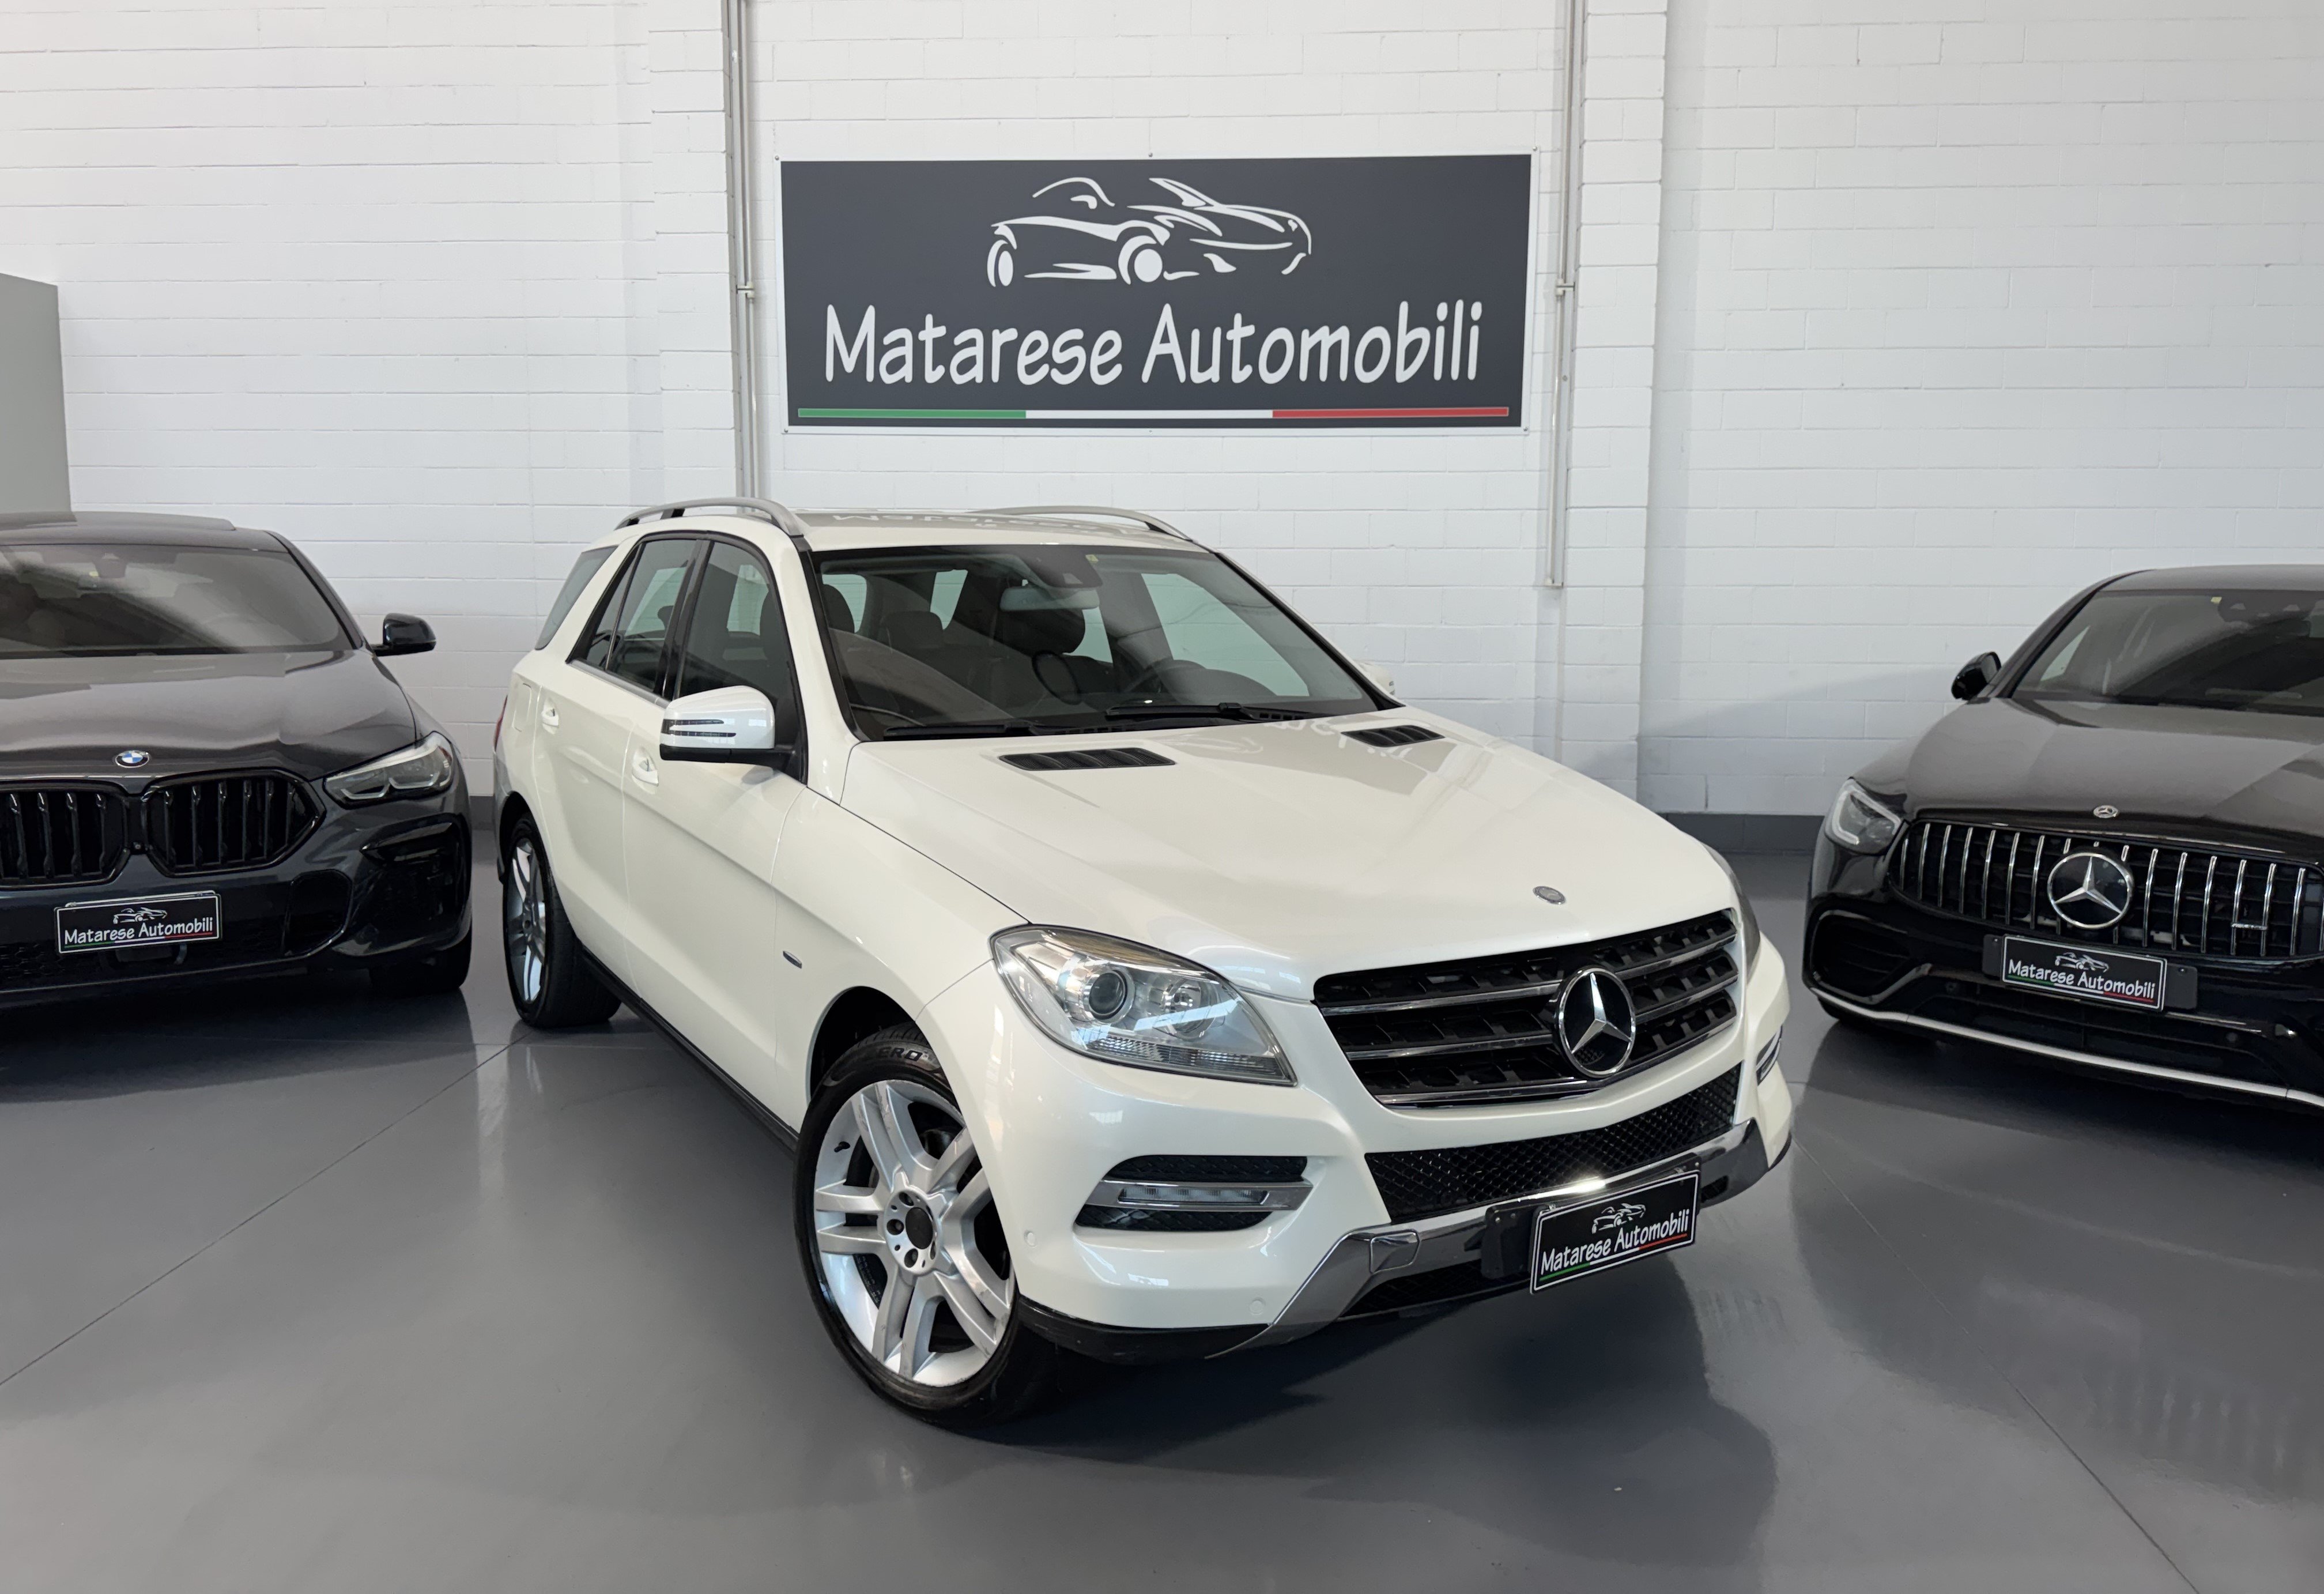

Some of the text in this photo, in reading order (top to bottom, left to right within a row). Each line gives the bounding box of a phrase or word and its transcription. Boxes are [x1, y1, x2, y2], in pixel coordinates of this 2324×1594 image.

[825, 299, 1482, 386] Matarese Automobili
[65, 917, 213, 945] Matarese Automobili
[2008, 959, 2156, 999] Matarese Automobili
[1541, 1208, 1689, 1275] Matarese Automobili
